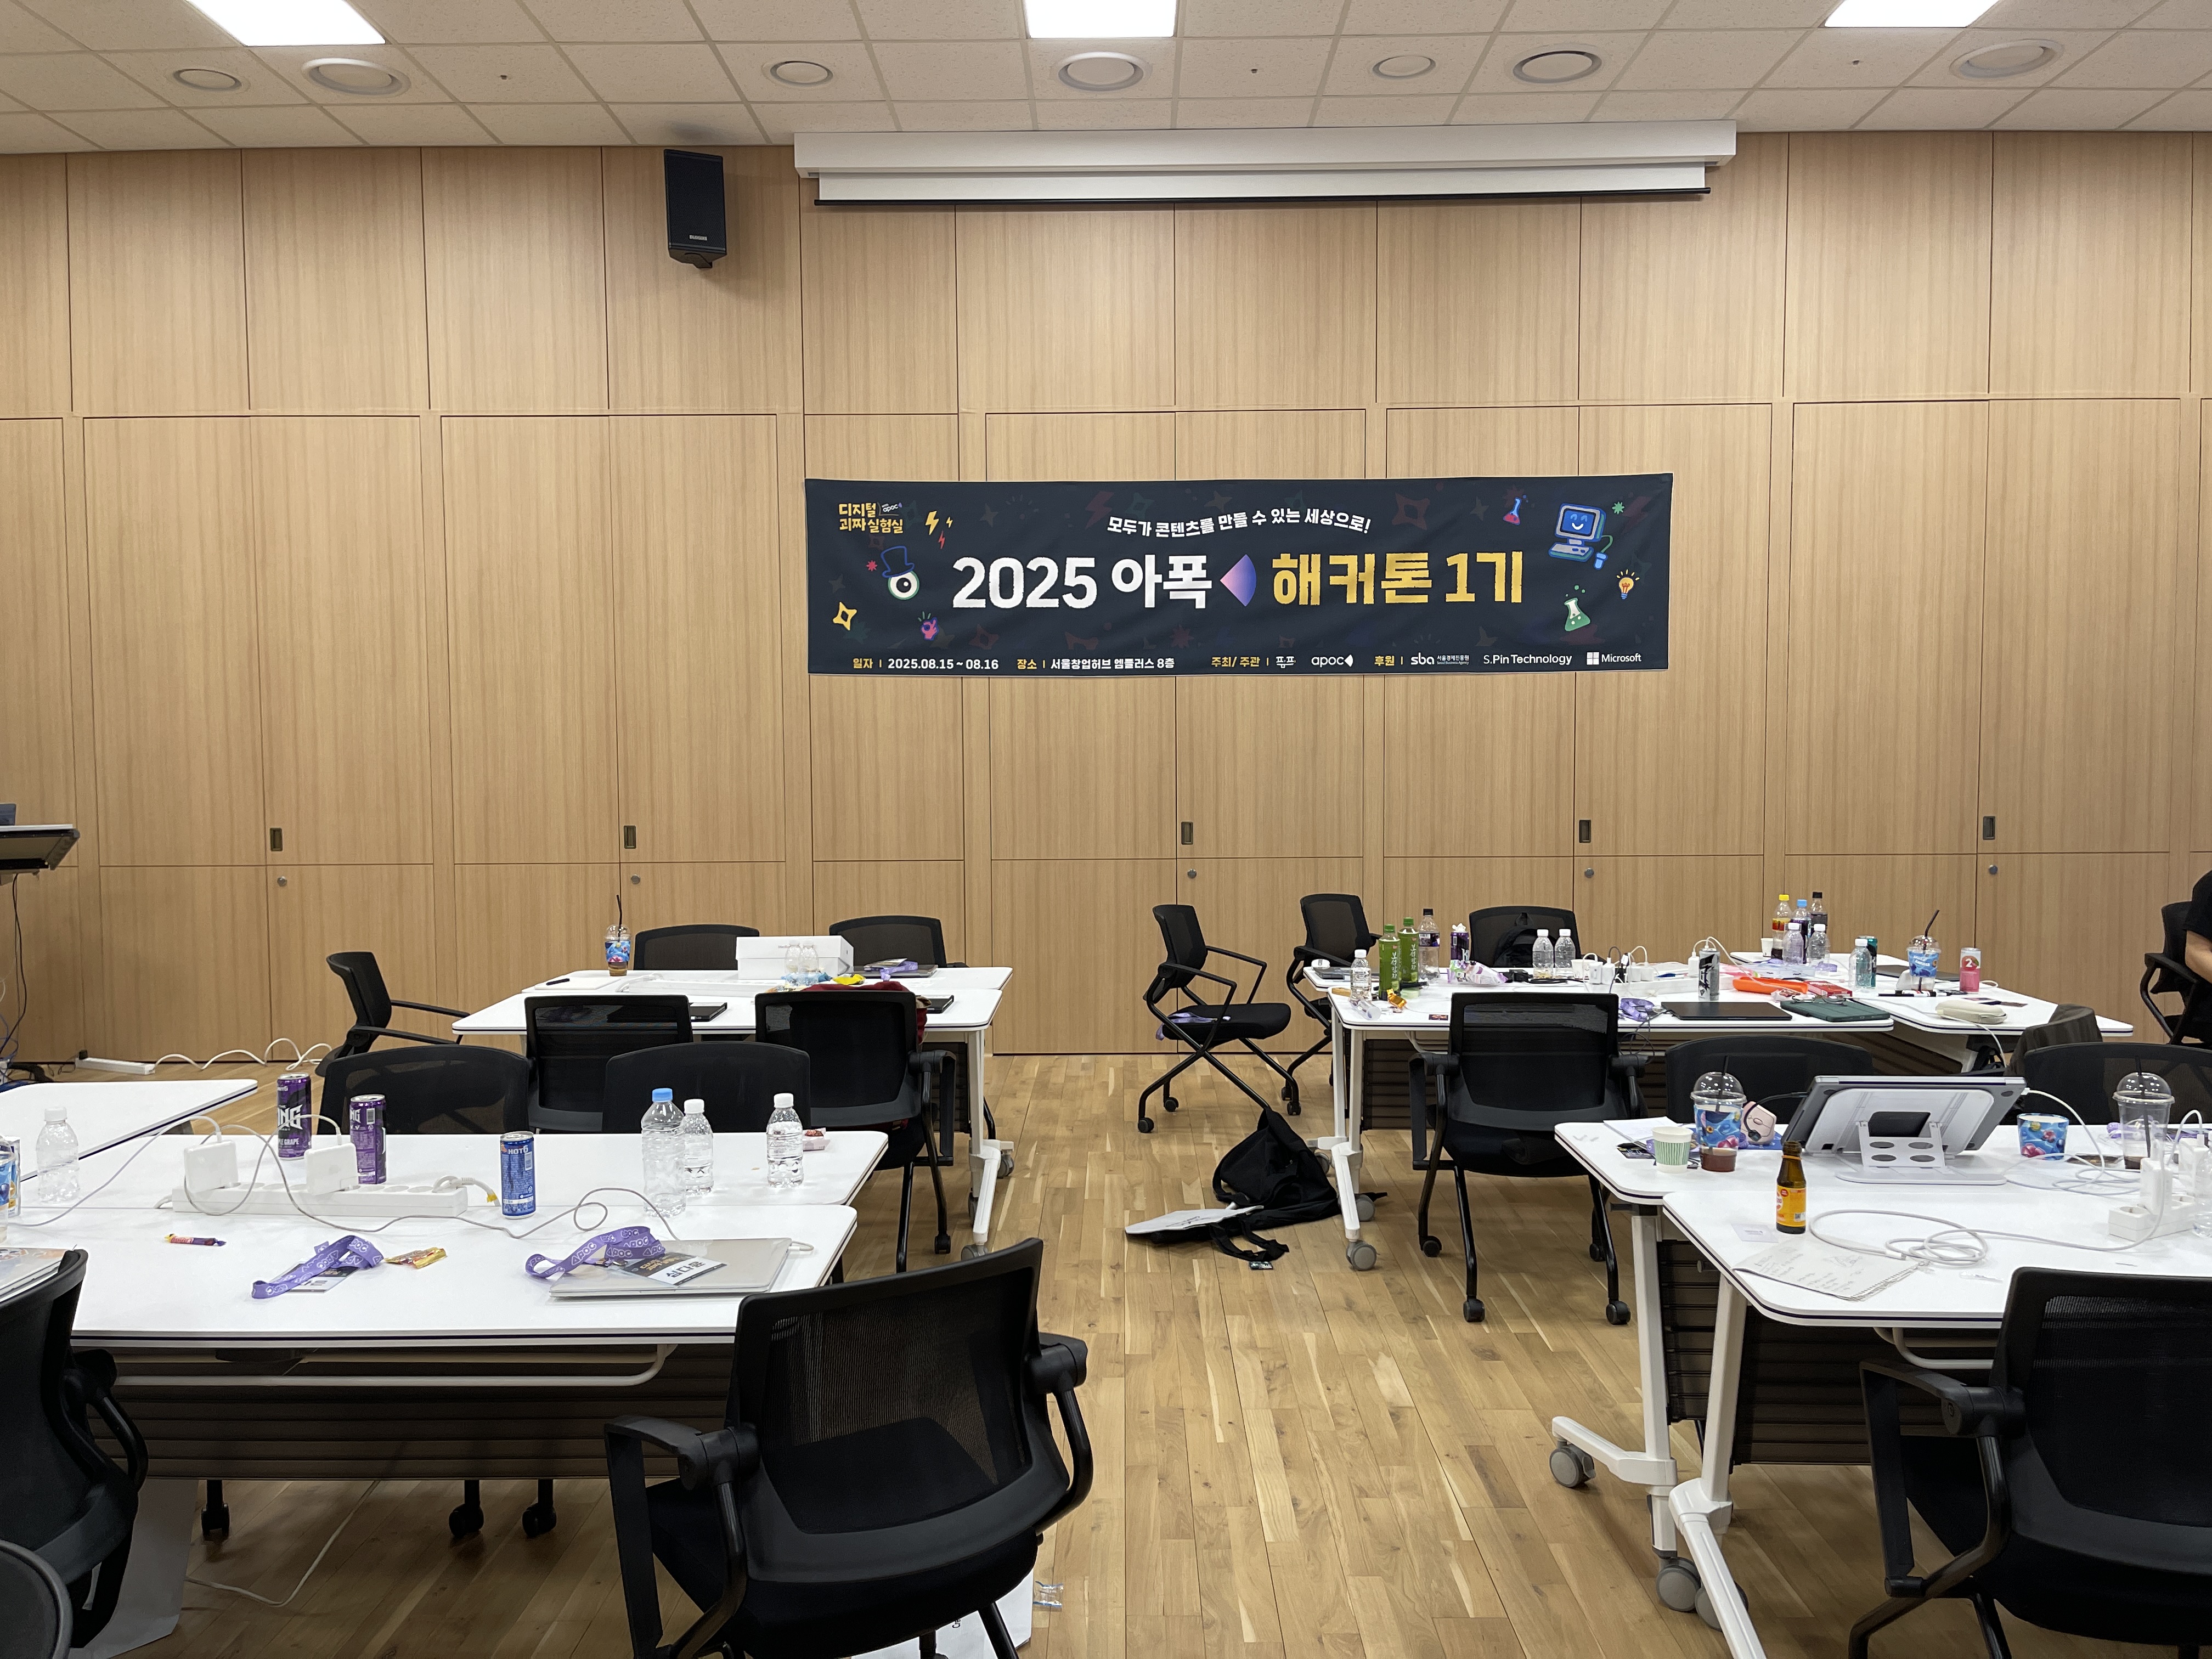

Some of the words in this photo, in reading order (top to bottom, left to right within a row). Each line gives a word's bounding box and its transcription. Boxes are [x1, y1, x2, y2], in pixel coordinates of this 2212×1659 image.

[838, 503, 876, 518] 디지털
[883, 504, 899, 512] apoc
[839, 517, 866, 531] 괴짜
[867, 518, 904, 534] 실험실
[1107, 516, 1152, 537] 모두가
[1155, 517, 1215, 538] 콘텐츠를
[1218, 511, 1248, 531] 만들
[1252, 510, 1267, 526] 수
[1271, 508, 1300, 524] 있는
[1304, 508, 1371, 534] 세상으로!
[952, 556, 1097, 608] 2025
[1111, 554, 1212, 609] 아폭
[1272, 552, 1432, 606] 해커톤
[1445, 551, 1523, 603] 1기
[853, 658, 873, 669] 일자
[888, 658, 954, 669] 2025.08.15
[966, 659, 998, 669] 08.16
[1017, 659, 1037, 669] 장소
[1051, 658, 1111, 669] 서울창업허브
[1114, 658, 1154, 669] 엠플러스
[1156, 658, 1175, 669] 8층
[1239, 656, 1260, 668] 주관
[1311, 656, 1344, 668] apoc
[1374, 656, 1395, 667] 후원
[1410, 652, 1435, 665] sba
[1483, 654, 1509, 664] S.Pin
[1511, 654, 1572, 665] Technology
[1601, 653, 1641, 663] Microsoft
[571, 1242, 597, 1266] APOC
[606, 1247, 633, 1257] APOC
